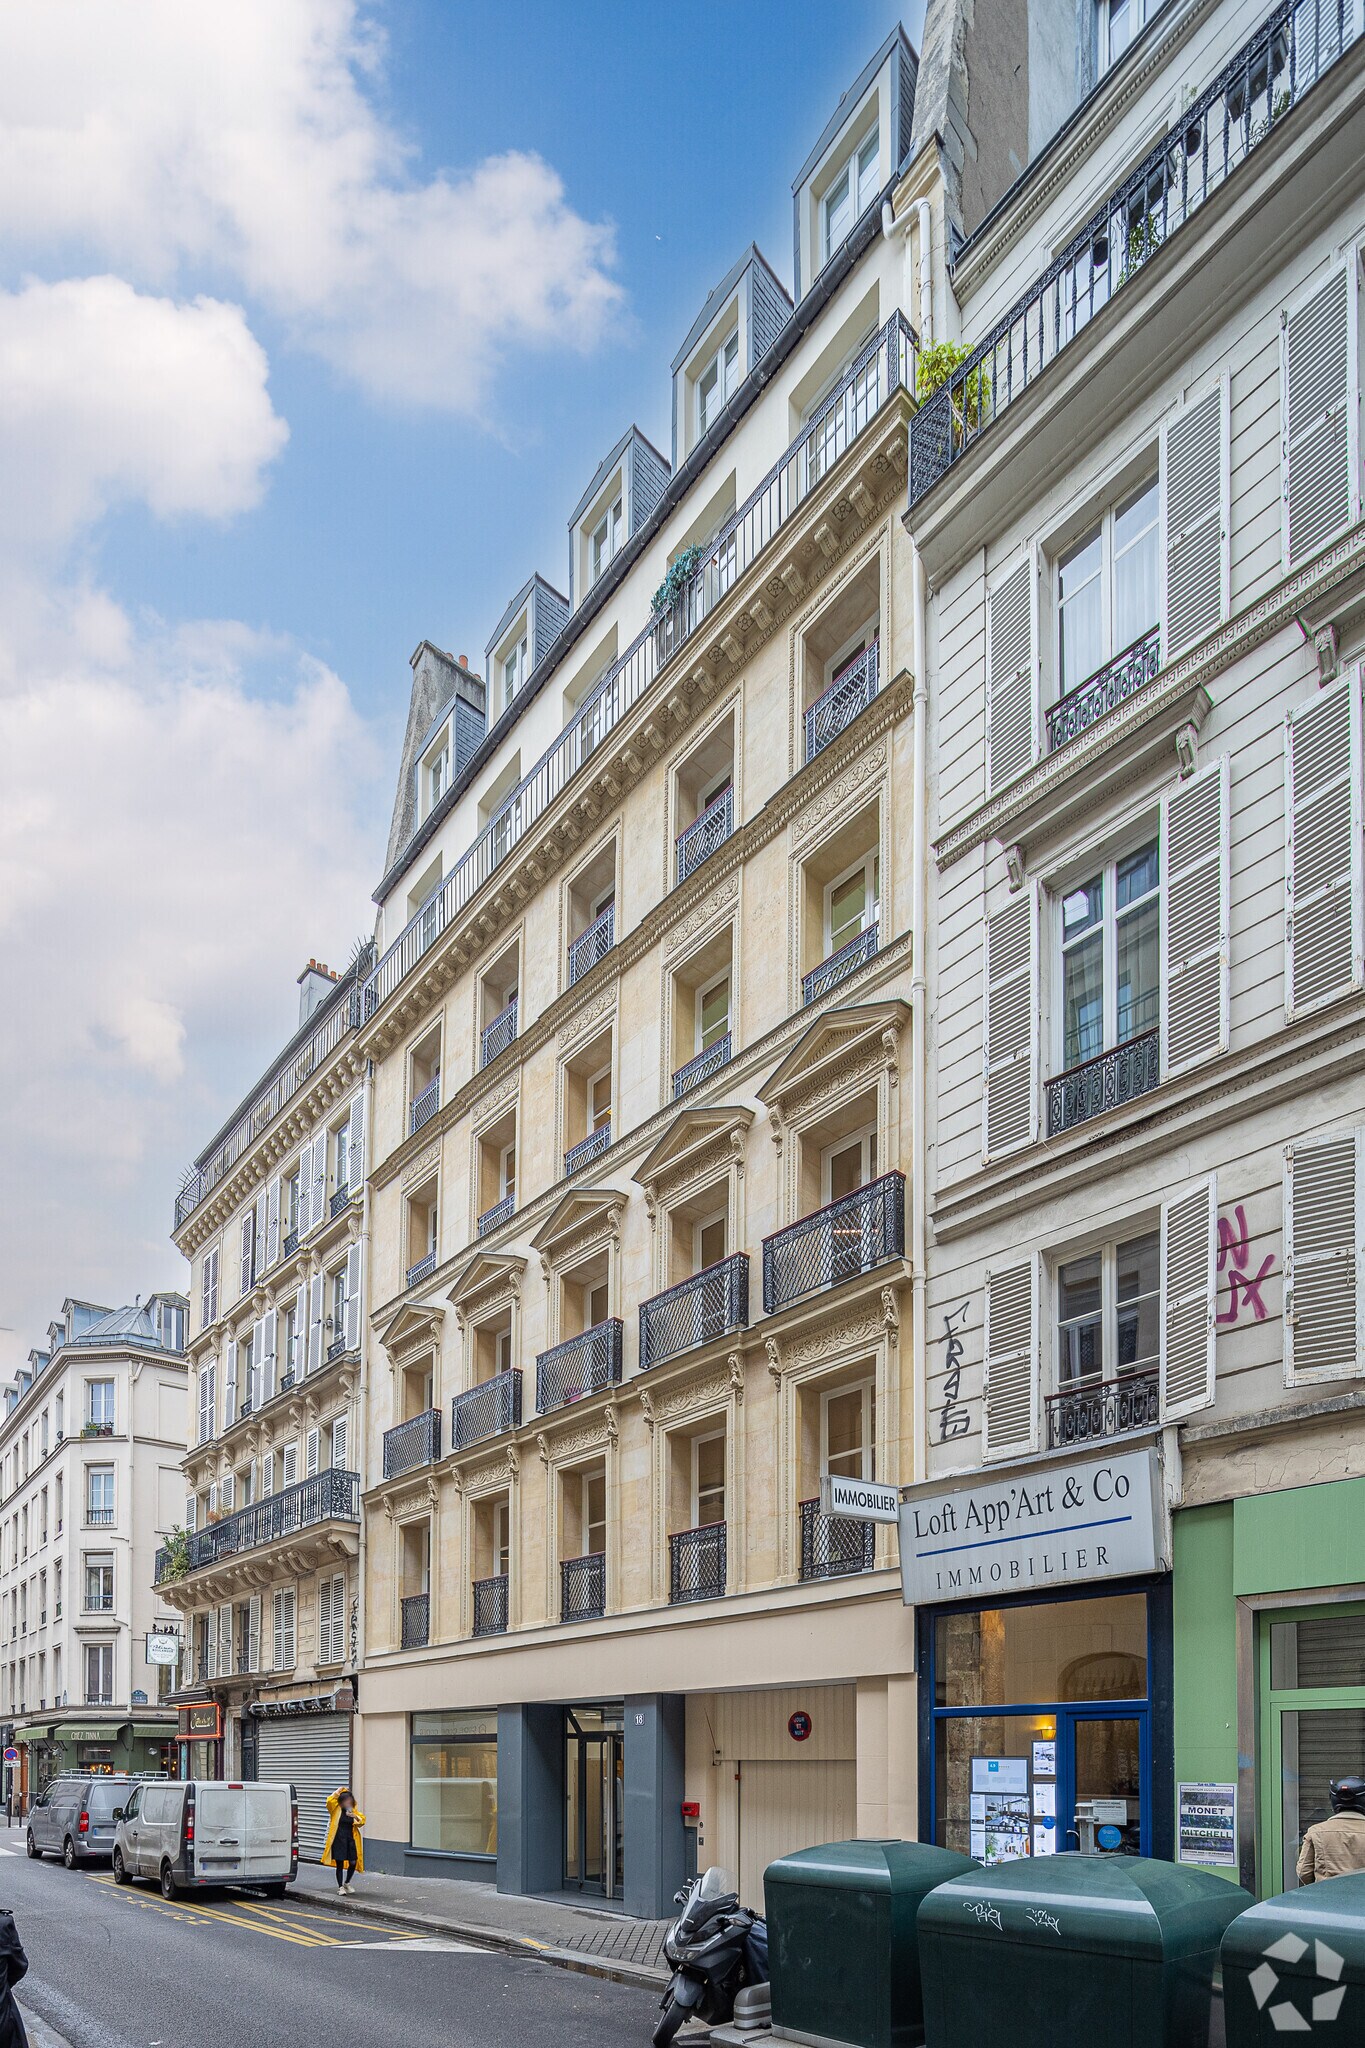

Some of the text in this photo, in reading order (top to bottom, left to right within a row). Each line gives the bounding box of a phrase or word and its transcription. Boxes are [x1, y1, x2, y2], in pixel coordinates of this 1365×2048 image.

[834, 1487, 897, 1512] IMMOBILIER
[912, 1468, 1130, 1539] Loft App'Art & Co
[936, 1546, 1110, 1590] IMMOBILIER
[635, 1715, 643, 1724] 18
[71, 1731, 84, 1740] CHEZ
[1187, 1806, 1226, 1815] MONET
[1181, 1829, 1232, 1839] MITCHELL
